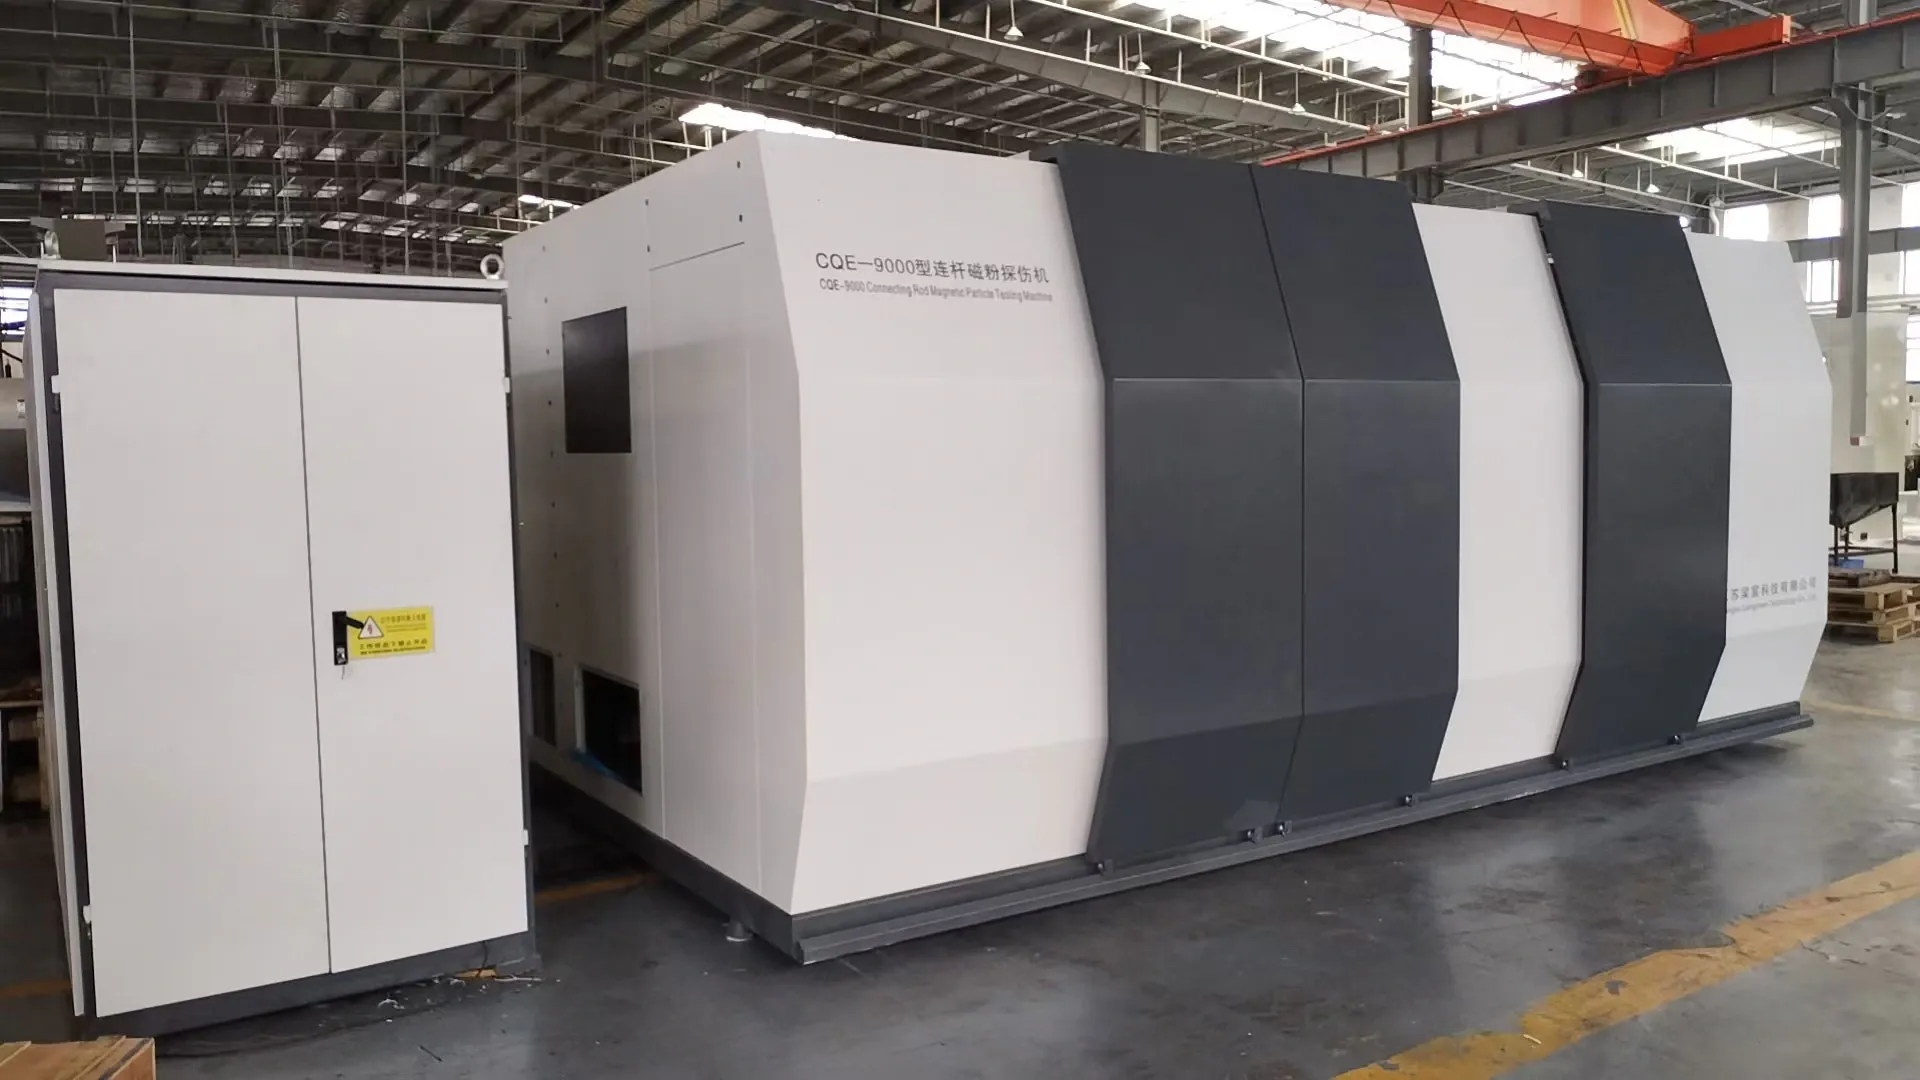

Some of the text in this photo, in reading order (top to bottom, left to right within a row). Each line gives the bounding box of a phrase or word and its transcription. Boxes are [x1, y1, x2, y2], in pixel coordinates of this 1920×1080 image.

[820, 278, 1053, 303] CQE-9000 Connecting Rod Magnetic Particle Testing Machine
